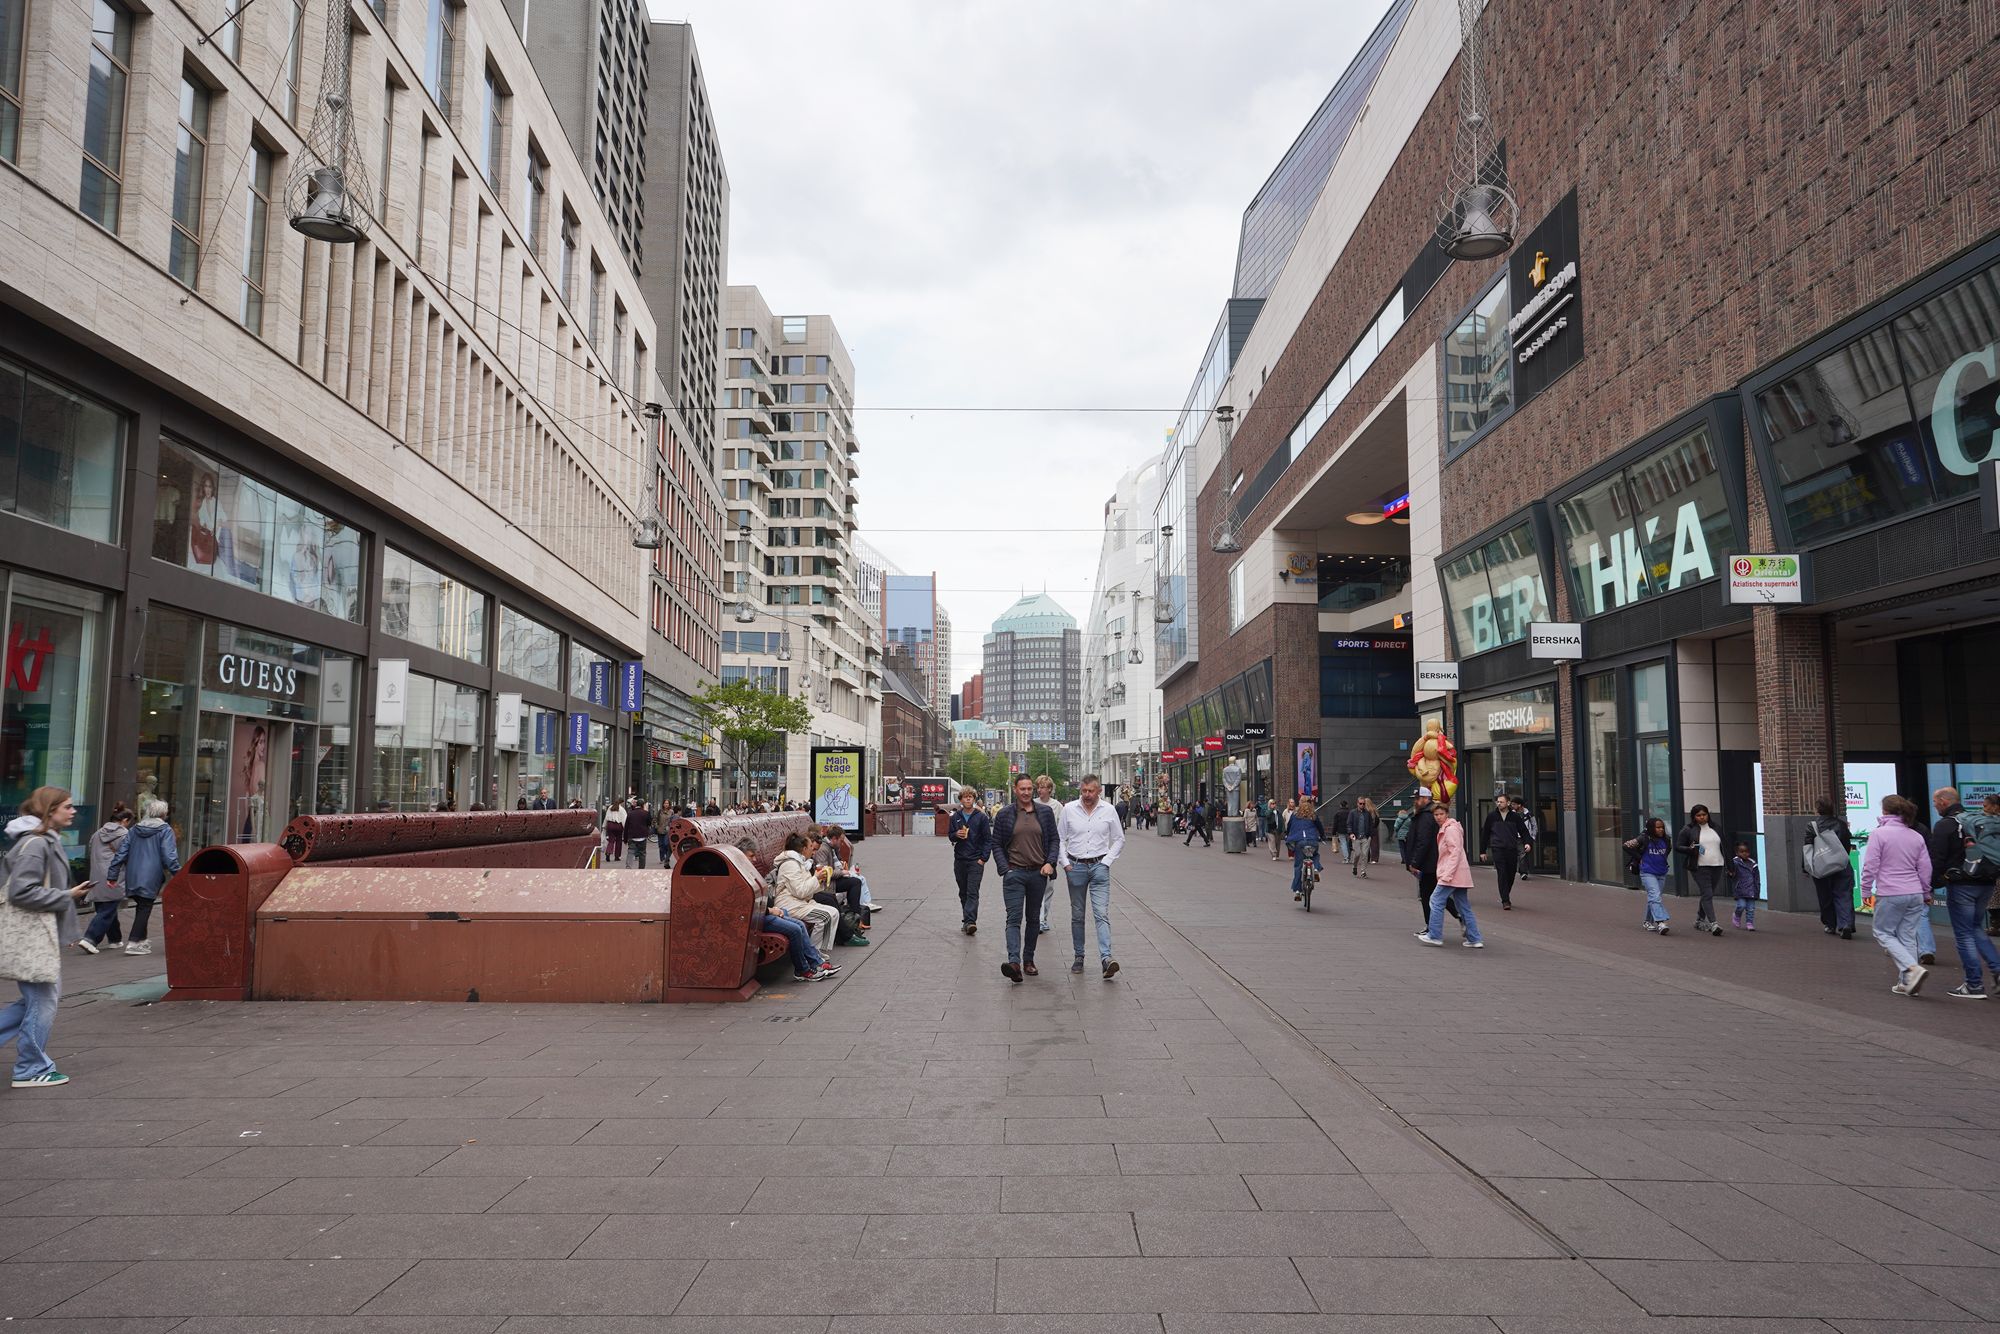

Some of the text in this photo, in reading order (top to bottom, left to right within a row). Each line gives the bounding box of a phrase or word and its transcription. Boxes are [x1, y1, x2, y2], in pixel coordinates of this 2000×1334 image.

[1931, 342, 2000, 476] C
[1764, 580, 1798, 588] supermarkt
[1337, 640, 1407, 649] SPORTS DIRECT
[1532, 636, 1581, 645] BERSHKA
[219, 654, 297, 695] GUESS
[1419, 671, 1458, 680] BERSHKA
[628, 665, 636, 700] DECATHLON
[1488, 706, 1535, 732] BERSHKA
[825, 756, 849, 765] Main
[824, 764, 851, 774] stage
[1845, 792, 1864, 800] NTAL
